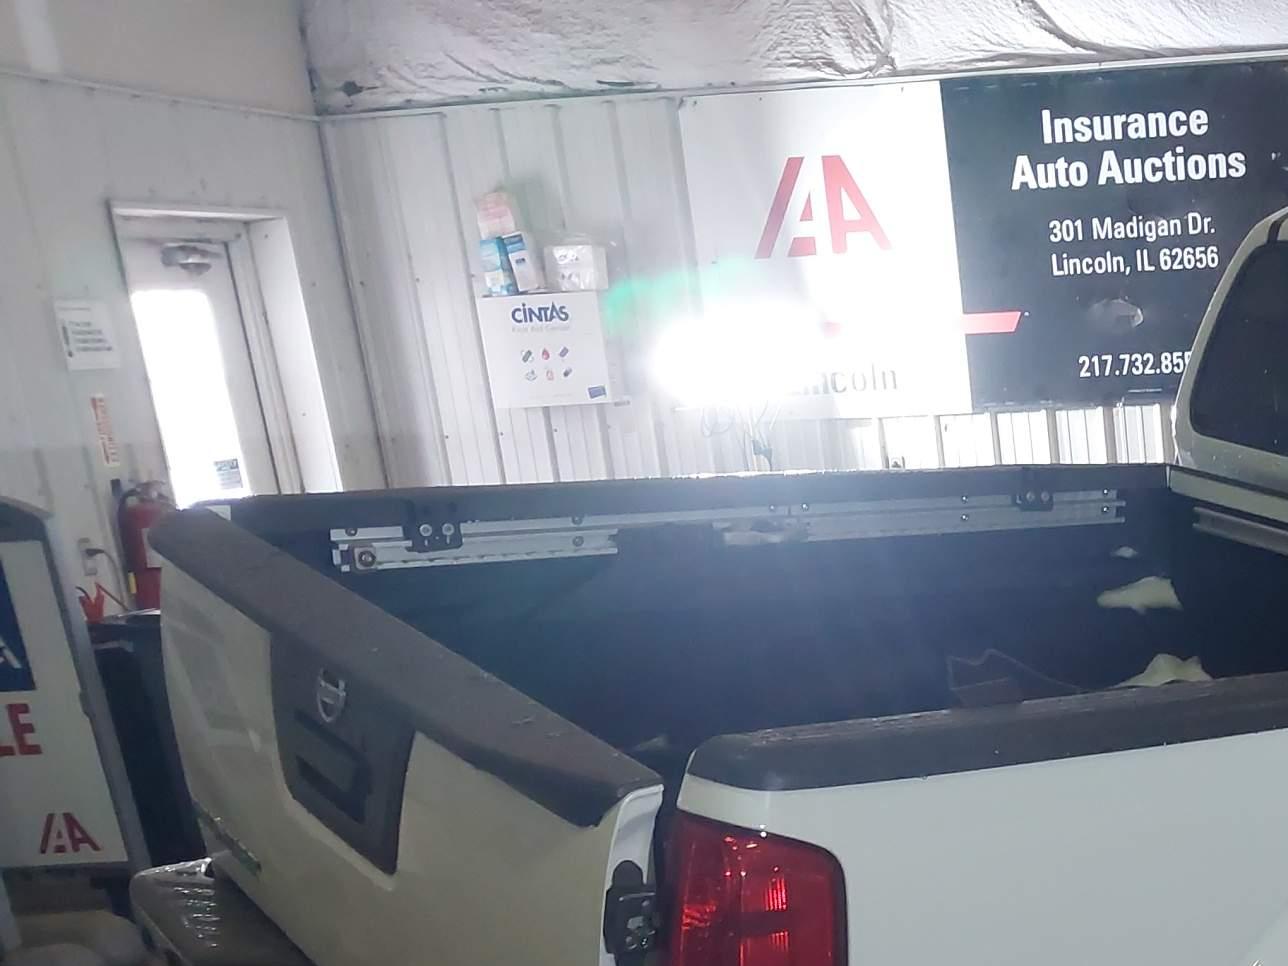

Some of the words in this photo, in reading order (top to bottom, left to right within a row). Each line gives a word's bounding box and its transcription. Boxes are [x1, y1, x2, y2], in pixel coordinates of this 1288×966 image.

[1041, 108, 1209, 144] Insurance
[1011, 155, 1088, 190] Auto
[1098, 146, 1247, 185] Auctions
[1049, 219, 1083, 243] 301
[1092, 215, 1182, 242] Madigan
[1187, 212, 1216, 235] Dr.
[1051, 251, 1131, 276] Lincoln,
[1136, 249, 1155, 272] IL
[1159, 246, 1219, 271] 62656
[511, 302, 570, 324] CINTAS
[789, 363, 899, 395] ncoln
